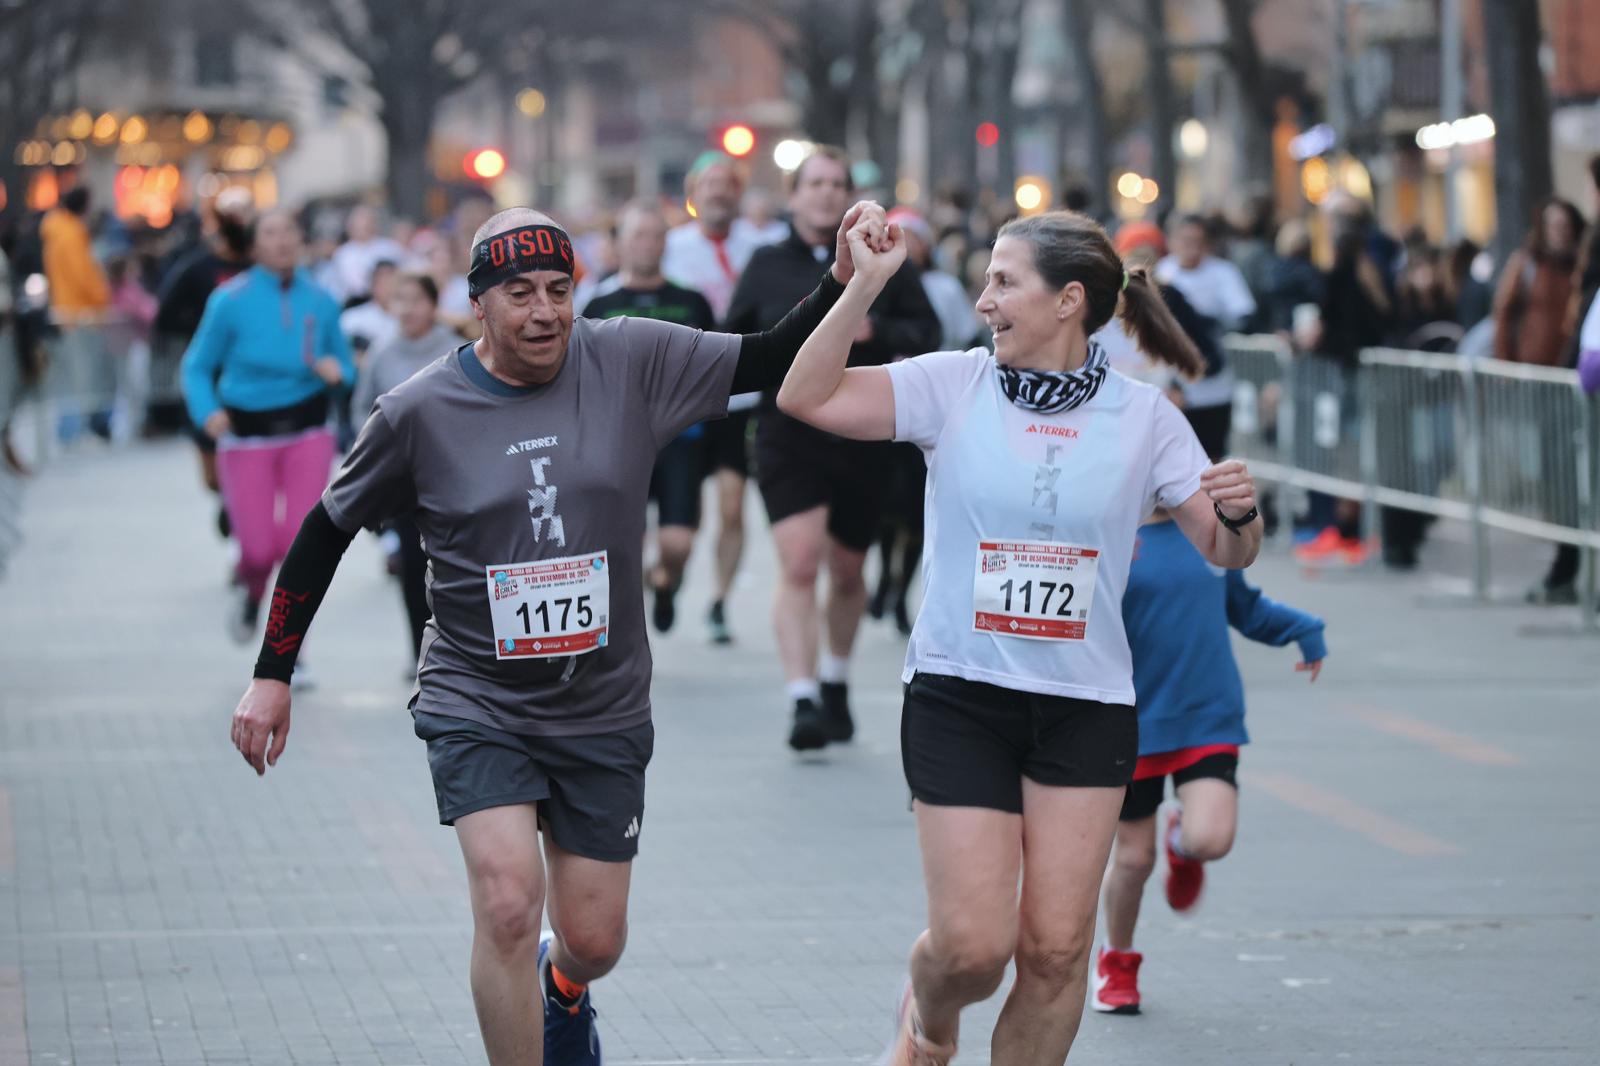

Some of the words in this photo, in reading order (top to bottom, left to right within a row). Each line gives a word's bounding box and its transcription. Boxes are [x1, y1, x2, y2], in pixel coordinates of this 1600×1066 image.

[490, 229, 554, 267] OTSO
[1039, 424, 1079, 439] TERREX
[519, 435, 558, 452] TERREX
[1029, 555, 1057, 564] DESEMBRE
[1058, 557, 1065, 565] DE
[1066, 557, 1078, 566] 2025
[524, 577, 530, 585] 31
[531, 575, 538, 584] DE
[539, 573, 568, 583] DESEMBRE
[569, 571, 576, 579] DE
[577, 569, 590, 578] 2025
[1000, 578, 1074, 617] 1172
[516, 594, 593, 635] 1175
